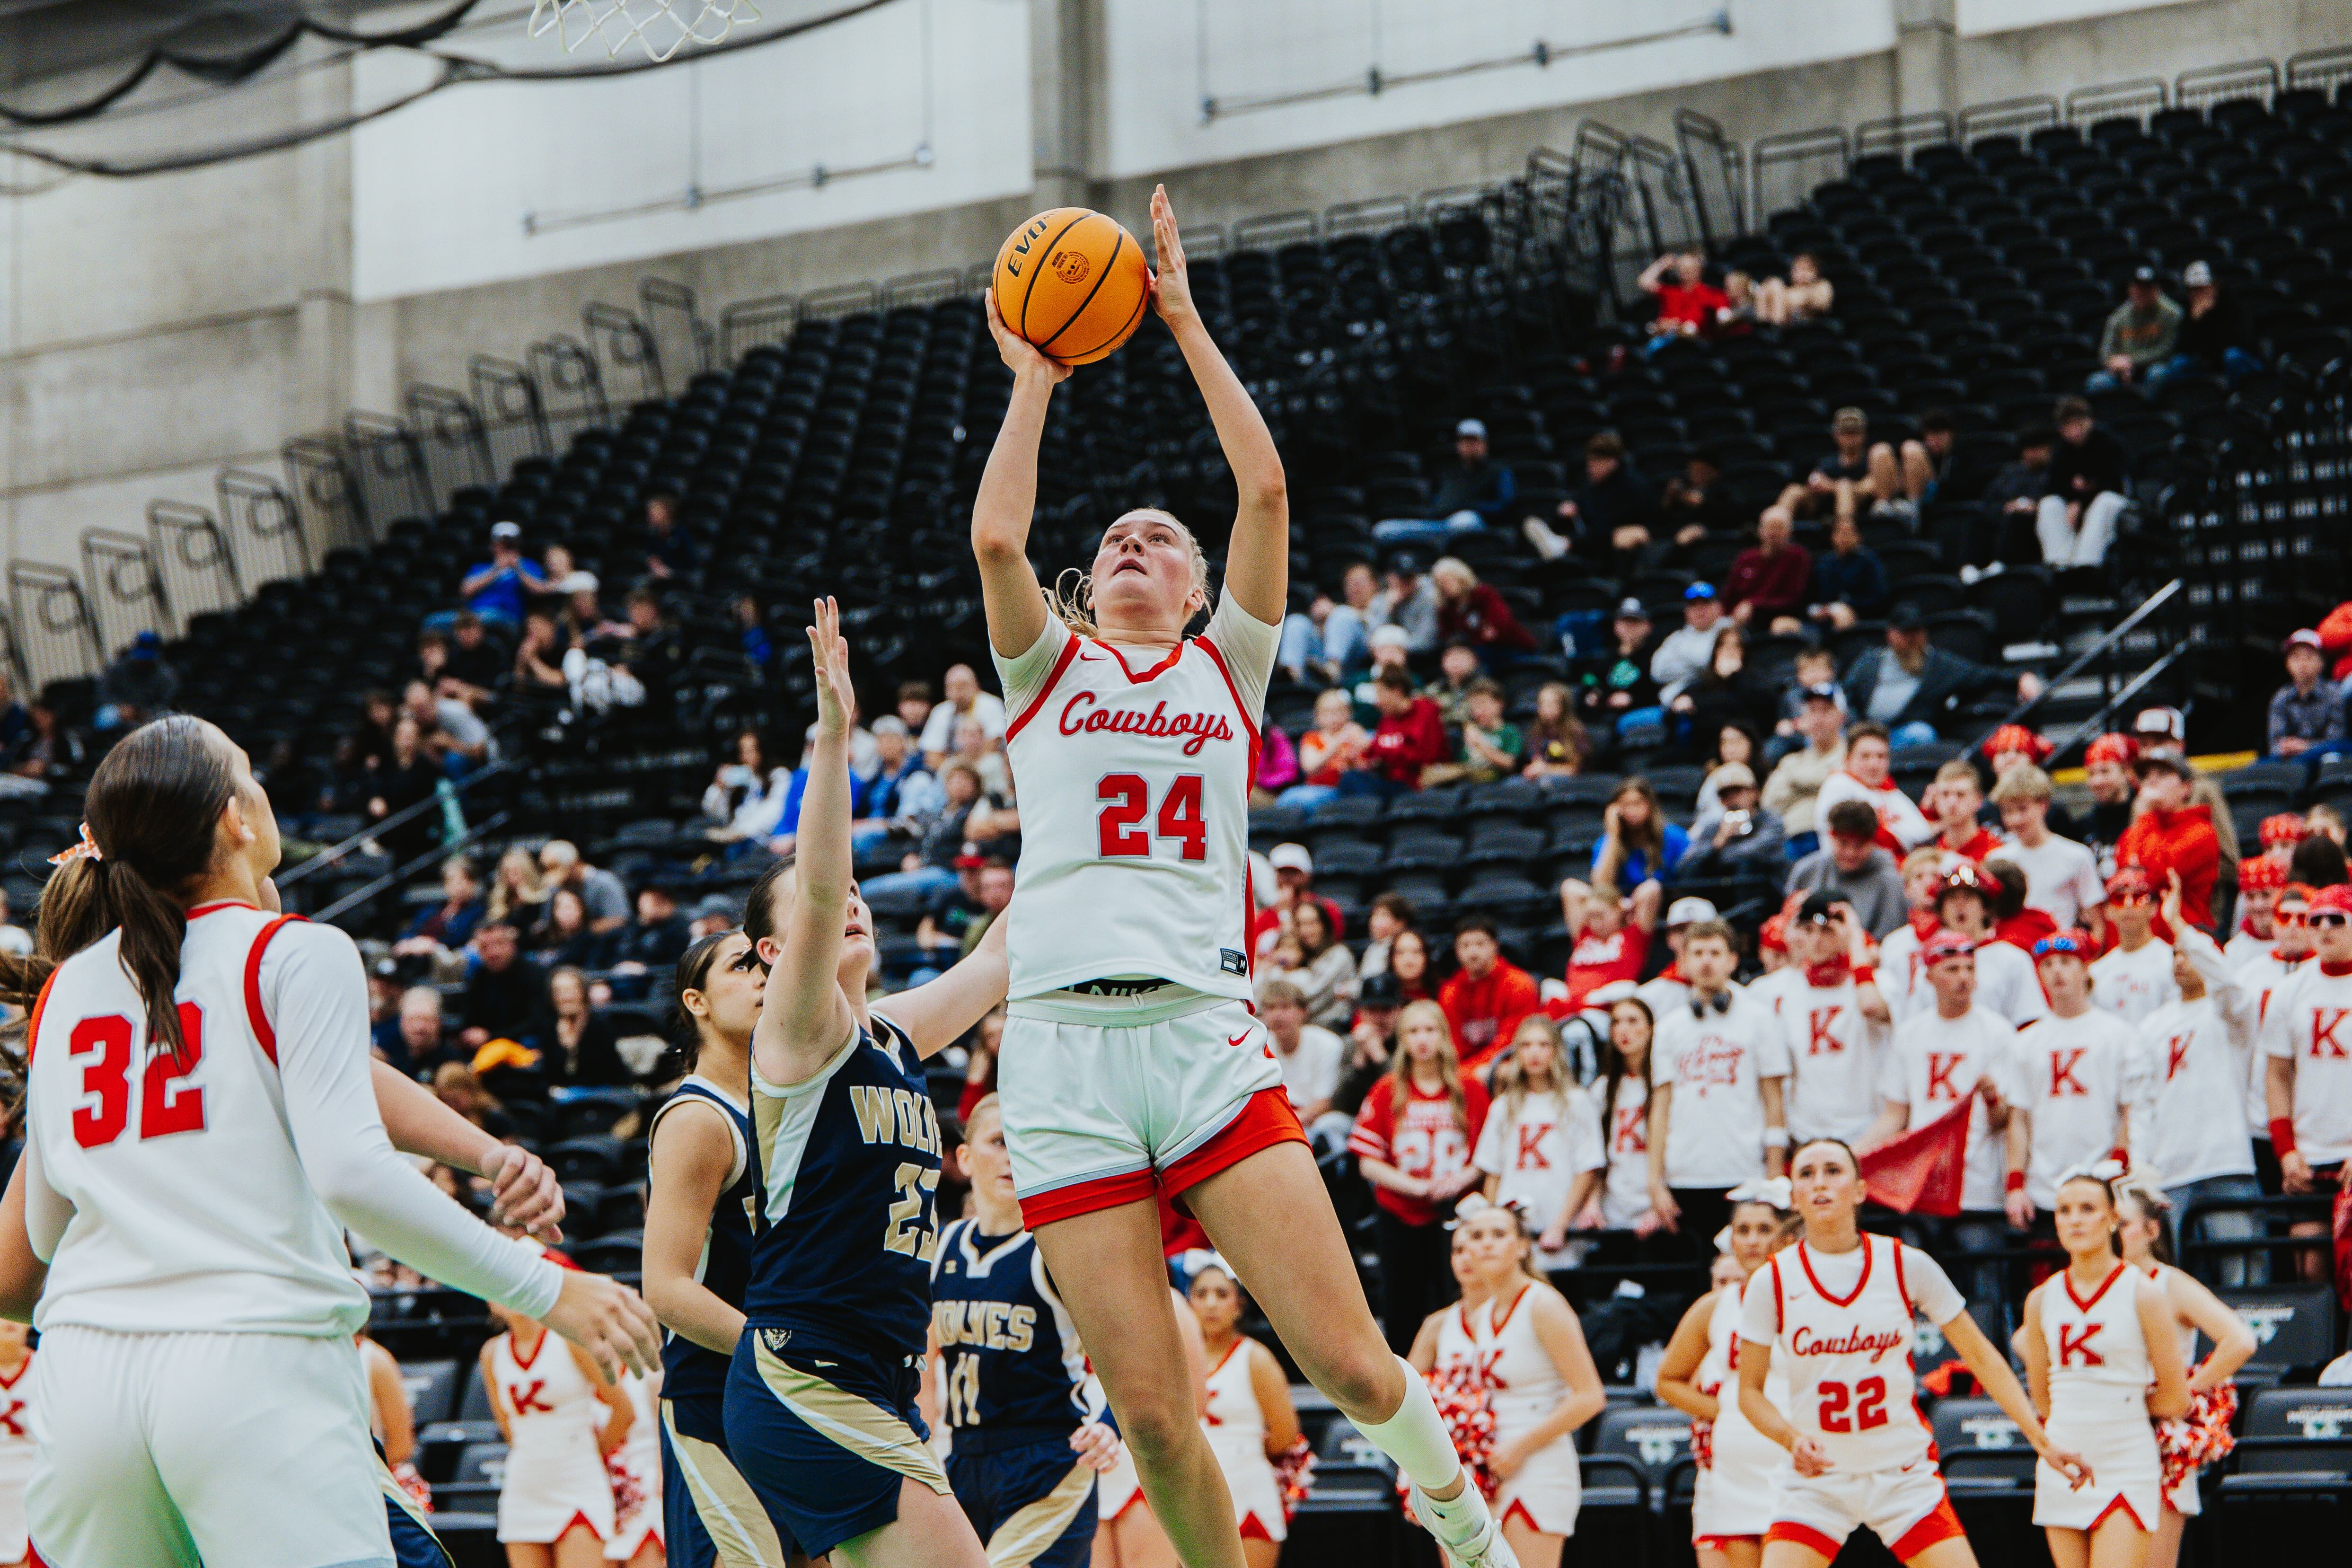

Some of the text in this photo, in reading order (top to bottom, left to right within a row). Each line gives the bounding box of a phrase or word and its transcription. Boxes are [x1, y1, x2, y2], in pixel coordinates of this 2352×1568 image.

[1007, 220, 1047, 278] EVO
[1059, 690, 1233, 757] Cowboys
[1095, 772, 1208, 863] 24
[1240, 959, 1245, 969] M
[1807, 1004, 1843, 1057] K
[2309, 1005, 2352, 1059] K
[69, 997, 208, 1151] 32
[1926, 1052, 1966, 1101] K
[2048, 1046, 2089, 1097] K
[1516, 1122, 1554, 1170] K
[1614, 1107, 1647, 1154] K
[1792, 1323, 1903, 1364] Cowboys
[2058, 1322, 2105, 1367] K
[509, 1378, 553, 1416] K
[950, 1352, 981, 1427] 11
[1817, 1375, 1888, 1433] 22
